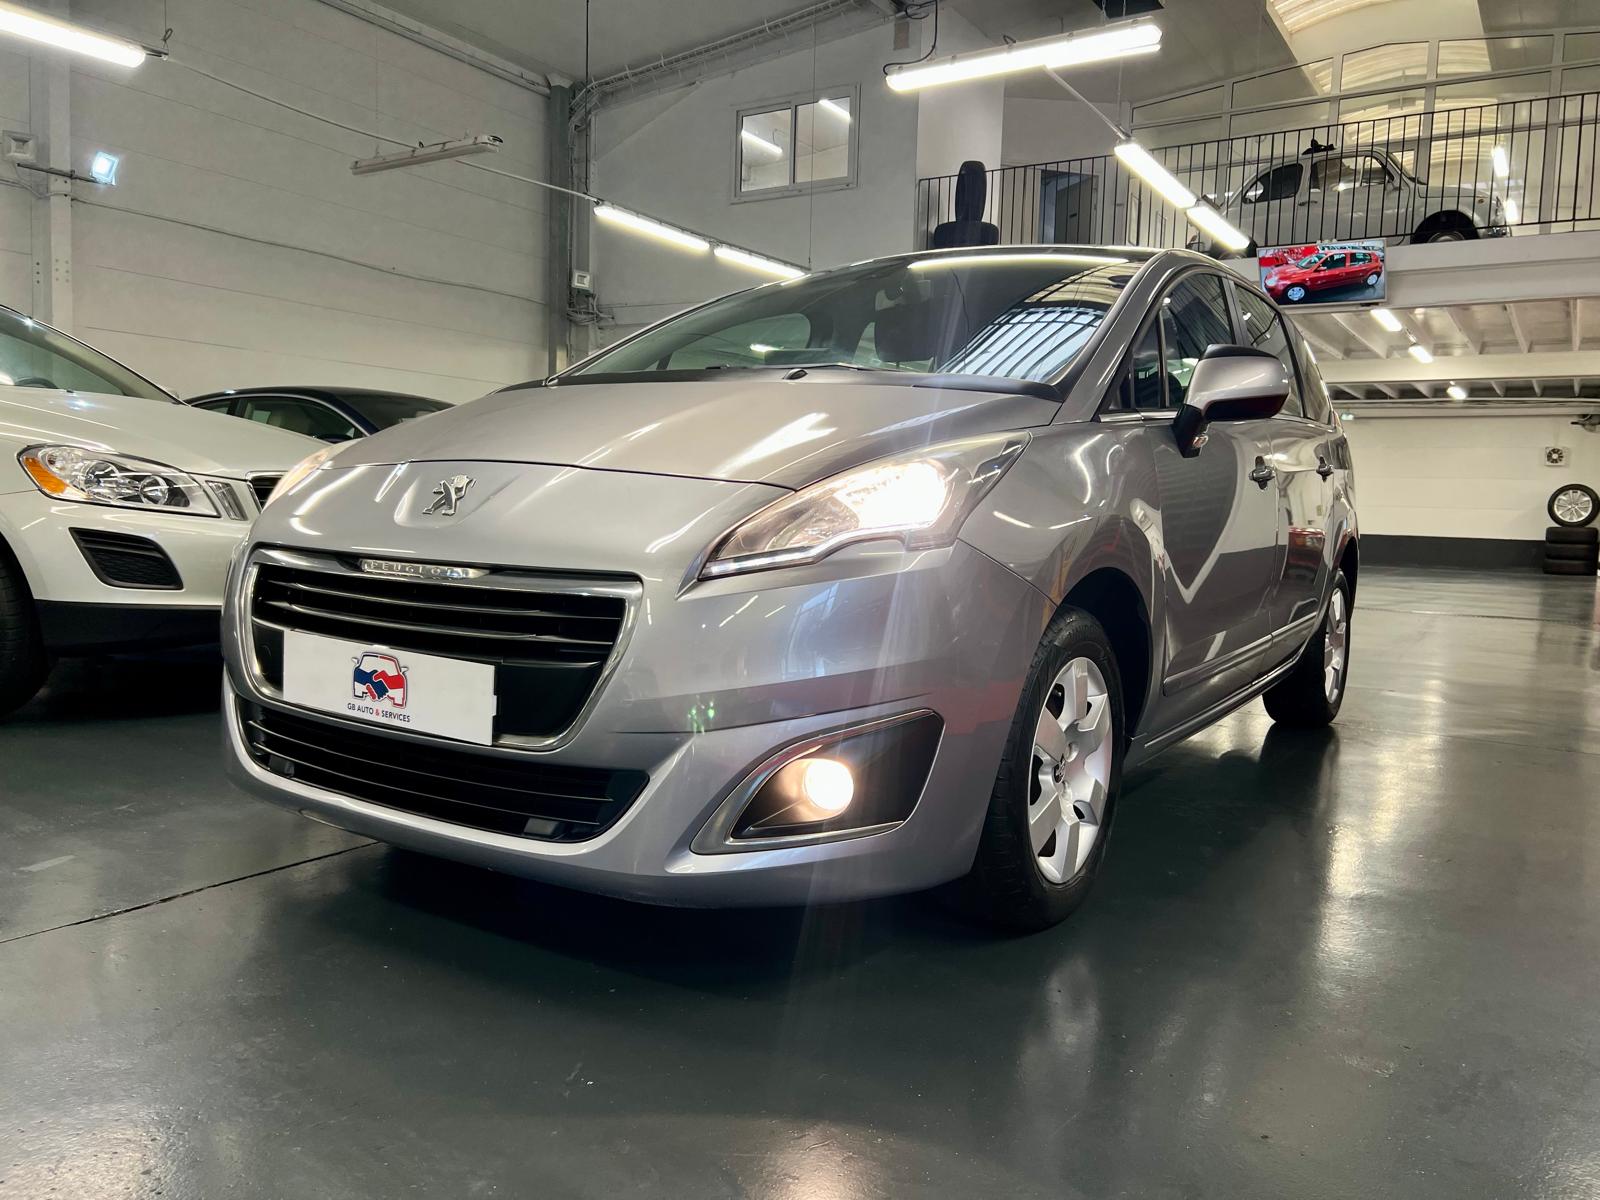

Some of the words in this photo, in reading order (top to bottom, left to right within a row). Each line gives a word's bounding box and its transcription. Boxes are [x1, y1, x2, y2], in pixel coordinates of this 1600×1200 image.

[347, 702, 356, 711] GB
[357, 705, 374, 715] AUTO
[375, 708, 380, 716] &
[381, 710, 411, 722] SERVICES
